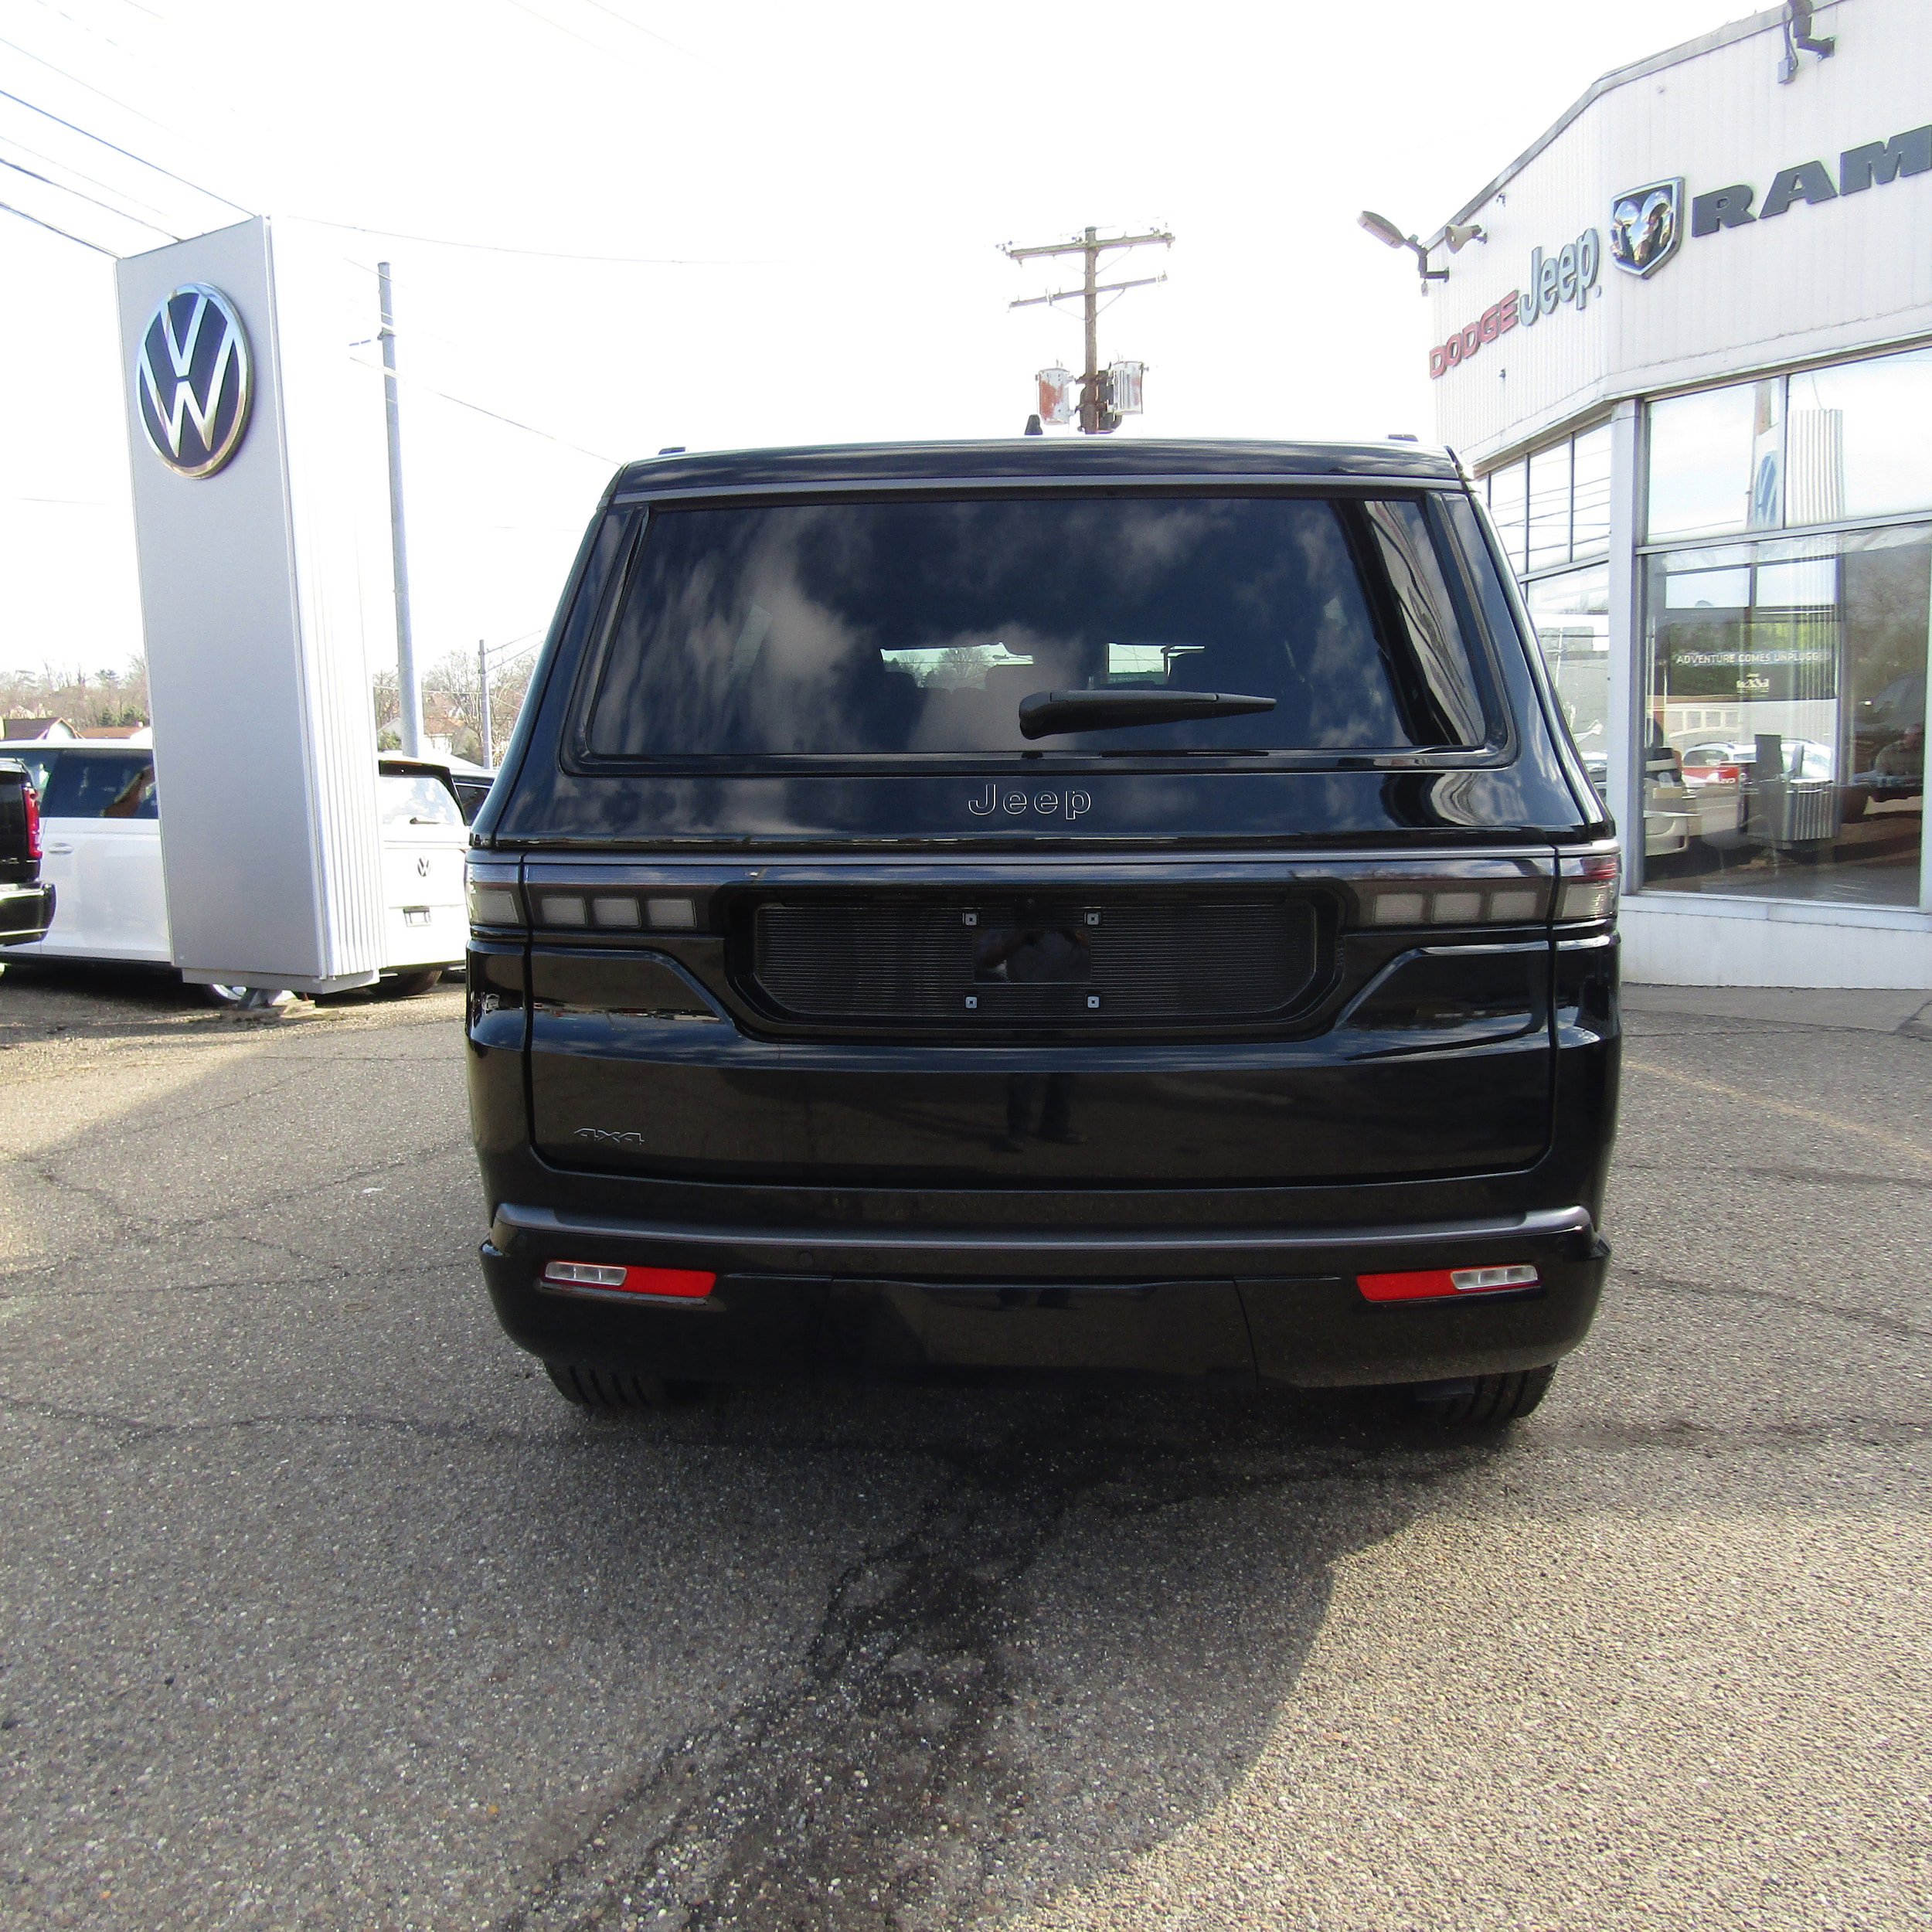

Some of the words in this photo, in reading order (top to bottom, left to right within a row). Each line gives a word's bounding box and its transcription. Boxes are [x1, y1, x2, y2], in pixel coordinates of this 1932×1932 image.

[1692, 124, 1932, 237] RAM
[1519, 227, 1600, 326] Jeep
[1429, 289, 1519, 379] DODGE
[1675, 653, 1736, 664] ADVENTURE
[1738, 652, 1770, 662] COMES
[968, 784, 1091, 820] Jeep
